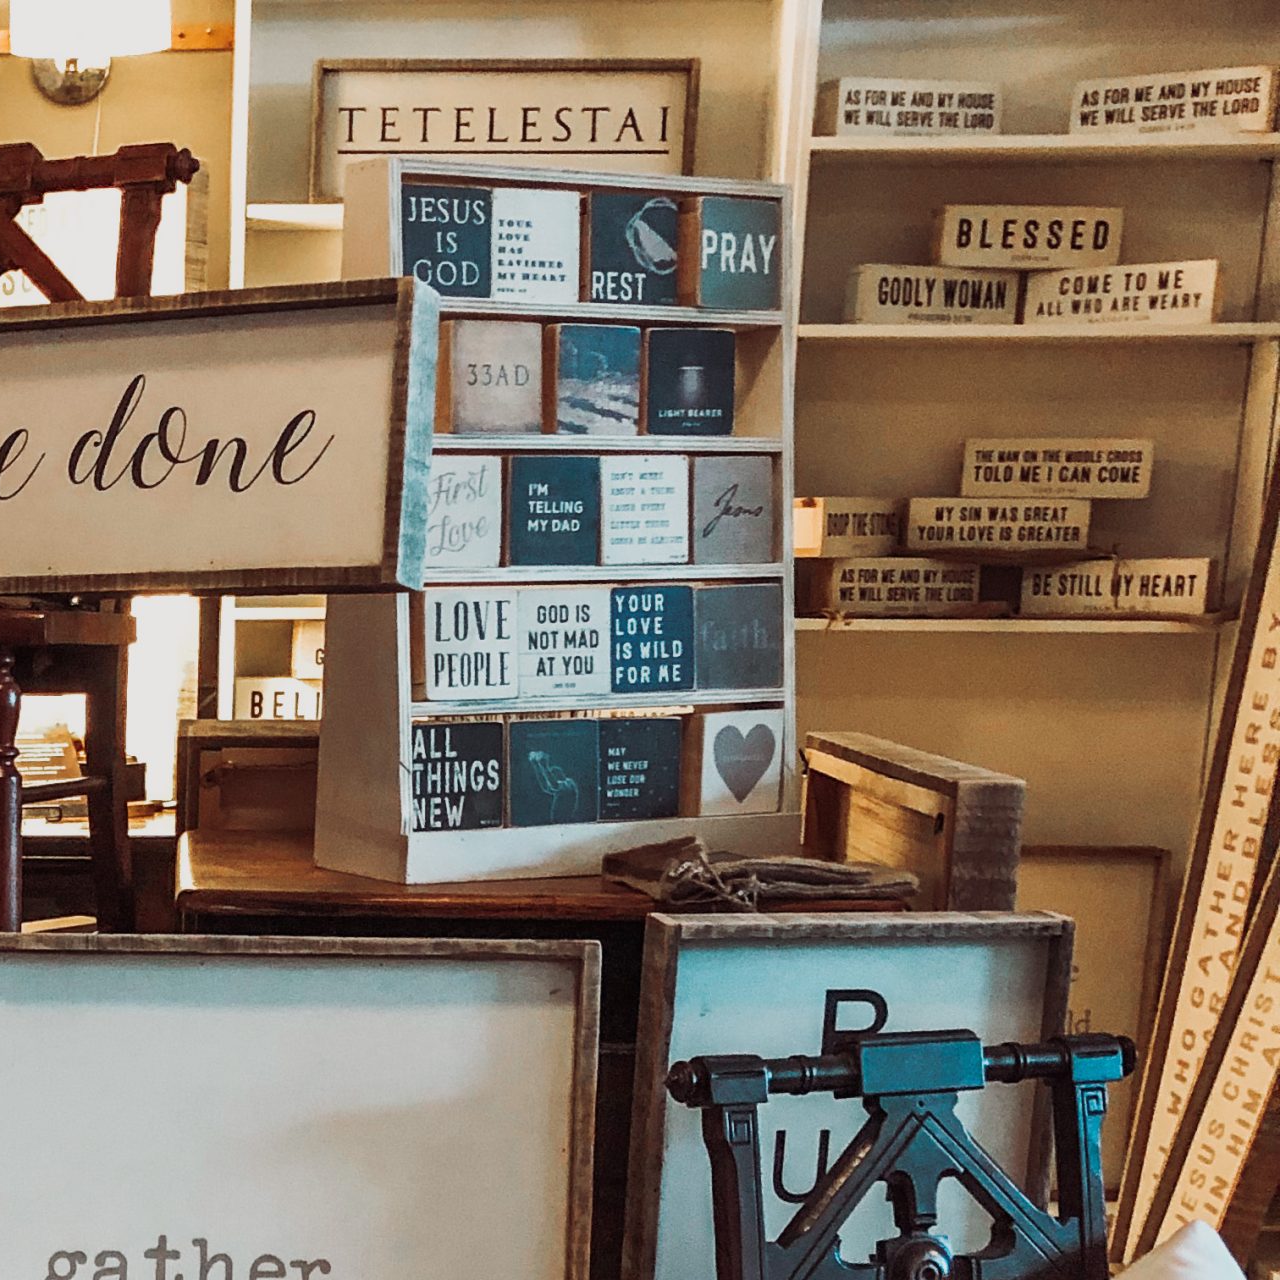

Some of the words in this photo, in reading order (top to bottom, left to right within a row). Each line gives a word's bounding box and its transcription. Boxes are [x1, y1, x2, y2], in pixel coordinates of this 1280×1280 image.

[1081, 91, 1099, 106] AS
[1104, 88, 1129, 105] FOR
[1135, 86, 1154, 102] ME
[1159, 83, 1185, 100] AND
[1191, 81, 1211, 98] MY
[1215, 77, 1262, 94] HOUSE
[337, 105, 671, 144] TETELESTAI
[1080, 110, 1098, 126] WE
[1105, 108, 1135, 124] WILL
[1141, 103, 1185, 122] SERVE
[1193, 101, 1218, 117] THE
[1223, 98, 1259, 115] LORD
[406, 197, 486, 226] JESUS
[436, 231, 457, 254] IS
[956, 218, 1110, 250] BLESSED
[700, 229, 778, 276] PRAY
[412, 259, 480, 286] GOD
[1059, 274, 1112, 296] COME
[1124, 272, 1147, 292] TO
[1157, 270, 1185, 290] ME
[592, 271, 647, 301] REST
[878, 277, 936, 307] GODLY
[943, 278, 1007, 309] WOMAN
[1036, 301, 1063, 316] ALL
[1071, 299, 1102, 314] WHO
[1110, 297, 1139, 312] ARE
[1148, 293, 1202, 310] WEARY
[466, 363, 530, 387] 33AD
[67, 375, 334, 491] done
[974, 465, 1013, 482] TOLD
[1019, 466, 1041, 482] ME
[1046, 466, 1053, 482] I
[1059, 466, 1091, 482] CAN
[1098, 465, 1141, 482] COME
[429, 464, 489, 514] First
[528, 482, 548, 497] I'M
[528, 501, 583, 515] TELLING
[935, 507, 953, 522] MY
[959, 507, 981, 522] SIN
[988, 507, 1018, 522] WAS
[1024, 507, 1068, 522] GREAT
[430, 516, 488, 556] Love
[528, 520, 548, 532] MY
[551, 520, 580, 532] DAD
[917, 526, 954, 541] YOUR
[959, 526, 993, 541] LOVE
[999, 526, 1012, 541] IS
[1017, 526, 1080, 542] GREATER
[1032, 573, 1053, 597] BE
[1058, 573, 1103, 597] STILL
[1139, 574, 1197, 597] HEART
[537, 604, 572, 624] GOD
[575, 605, 590, 622] IS
[615, 594, 665, 613] YOUR
[434, 600, 511, 642] LOVE
[616, 617, 663, 636] LOVE
[528, 630, 559, 651] NOT
[564, 629, 599, 649] MAD
[616, 641, 632, 660] IS
[639, 640, 683, 658] WILD
[434, 652, 511, 688] PEOPLE
[536, 657, 558, 676] AT
[563, 656, 594, 676] YOU
[616, 665, 652, 684] FOR
[658, 664, 682, 682] ME
[412, 728, 458, 760] ALL
[413, 759, 500, 795] THINGS
[412, 796, 465, 829] NEW
[1167, 1028, 1196, 1116] WHO
[1191, 828, 1240, 1009] GATHER
[1232, 690, 1269, 808] HERE
